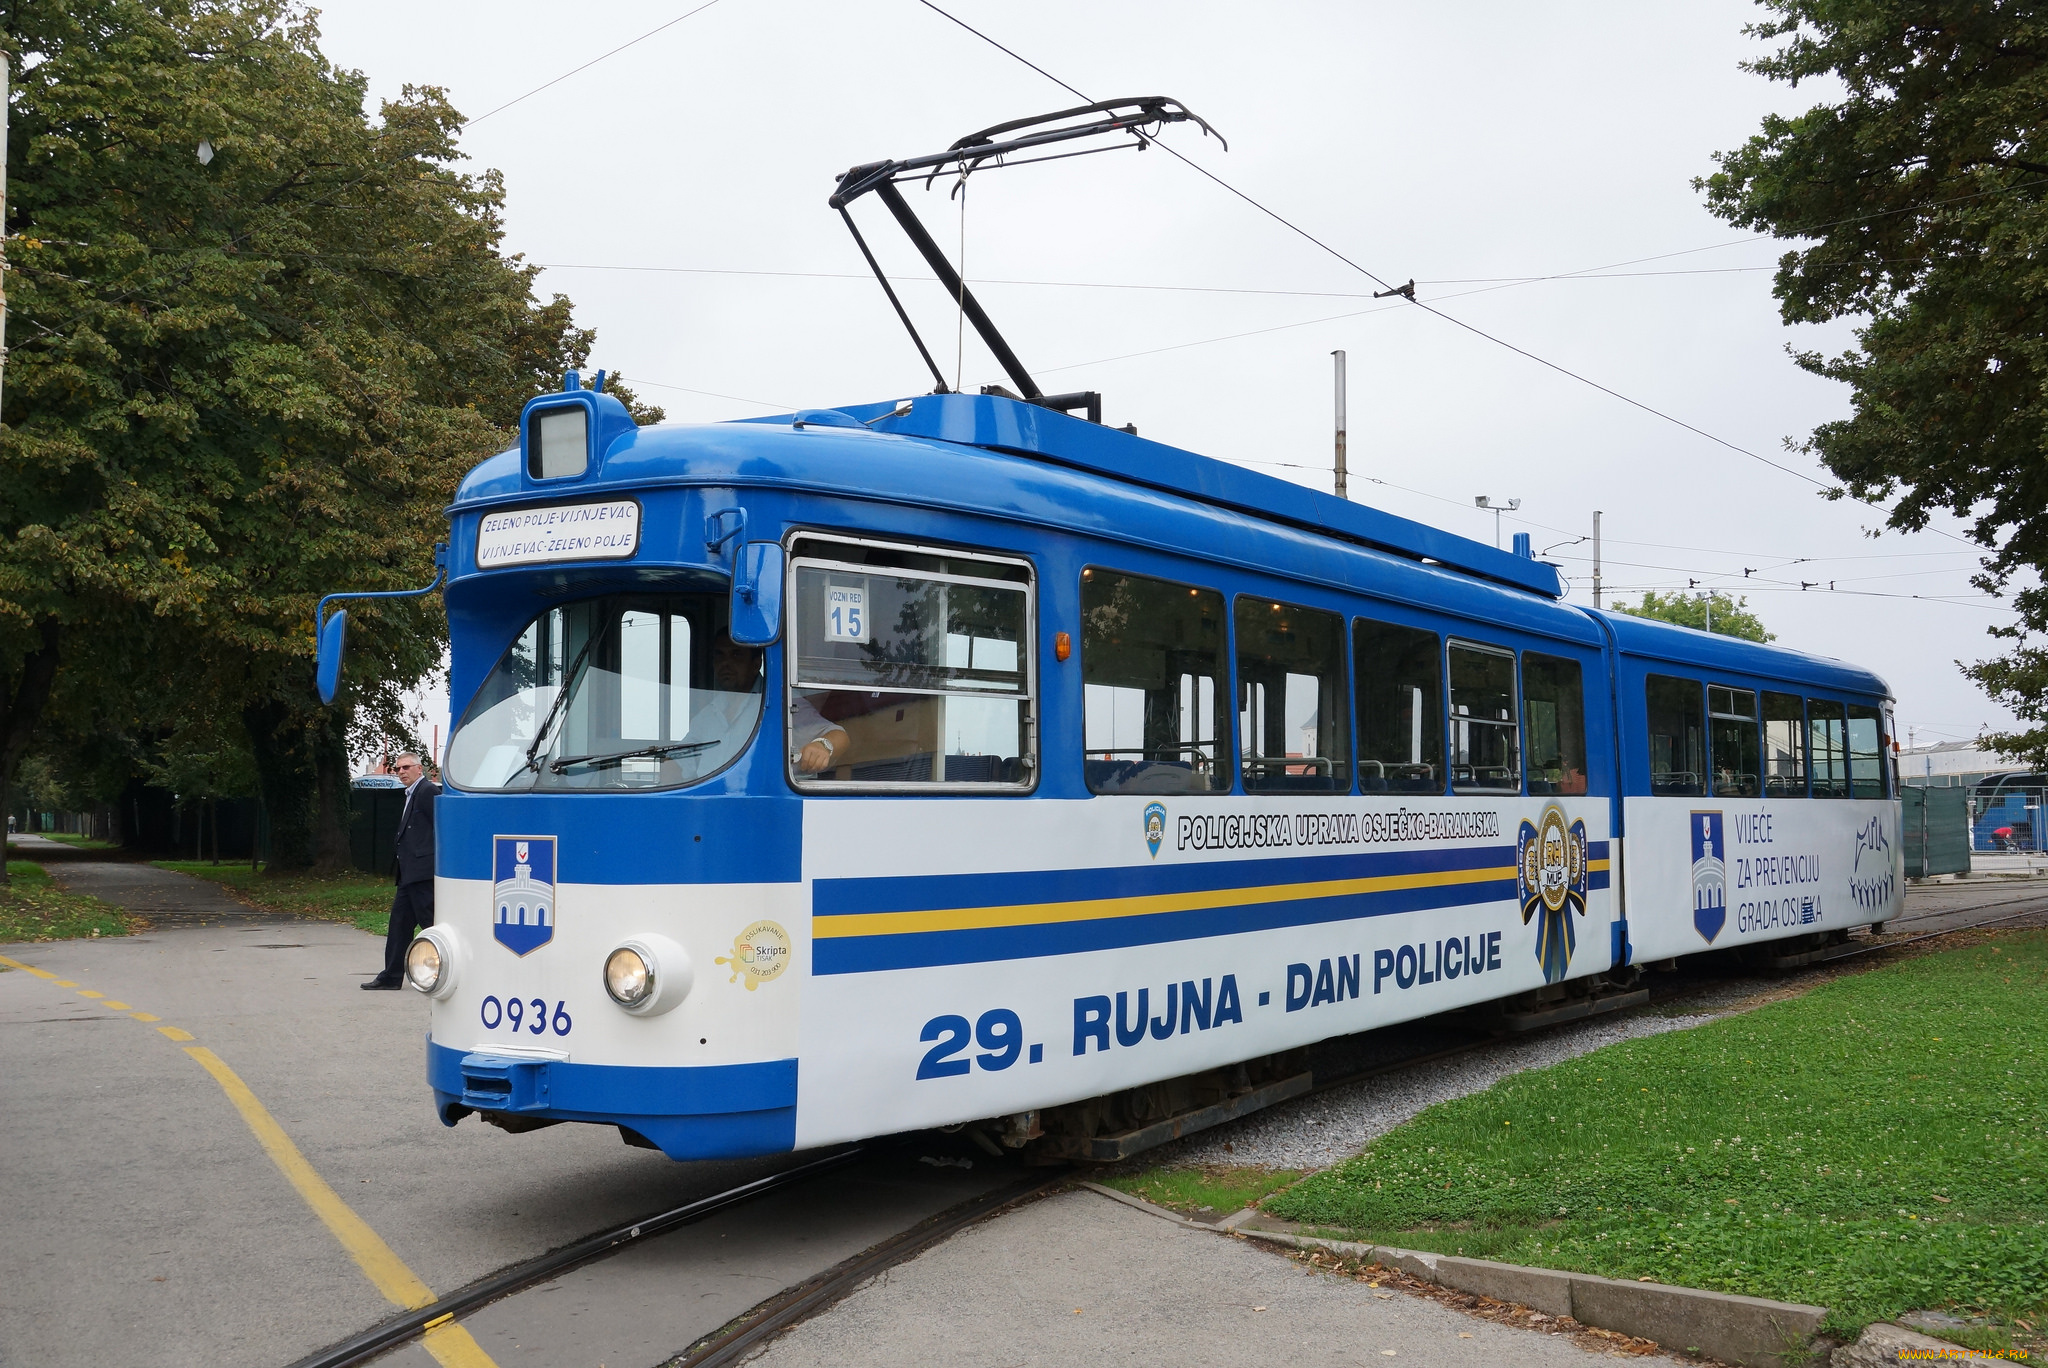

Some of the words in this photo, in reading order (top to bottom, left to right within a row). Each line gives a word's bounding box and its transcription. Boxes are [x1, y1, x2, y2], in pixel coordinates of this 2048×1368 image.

[485, 516, 522, 533] ZELENO
[593, 533, 632, 548] POLJE
[830, 591, 848, 602] VOZNI
[850, 593, 861, 603] RED
[831, 606, 862, 637] 15
[1178, 814, 1293, 851] POLICIJSKA
[1295, 813, 1360, 846] UPRAVA
[1361, 807, 1500, 844] OSJEČKO-BARANJSKA
[1734, 805, 1773, 844] VIJEĆE
[1546, 839, 1561, 867] RH
[1546, 871, 1563, 886] MUP
[1737, 858, 1753, 888] ZA
[1755, 854, 1820, 887] PREVENCIJU
[1738, 899, 1779, 933] GRADA
[745, 926, 783, 940] OSLIKAVANJE
[756, 946, 786, 956] Skripta
[750, 966, 761, 976] 031
[761, 969, 772, 977] 203
[771, 962, 782, 973] 900
[481, 995, 572, 1036] 0936
[915, 1008, 1043, 1080] 29.
[1073, 974, 1242, 1056] RUJNA
[1286, 953, 1360, 1013] DAN
[1373, 930, 1502, 994] POLICIJE
